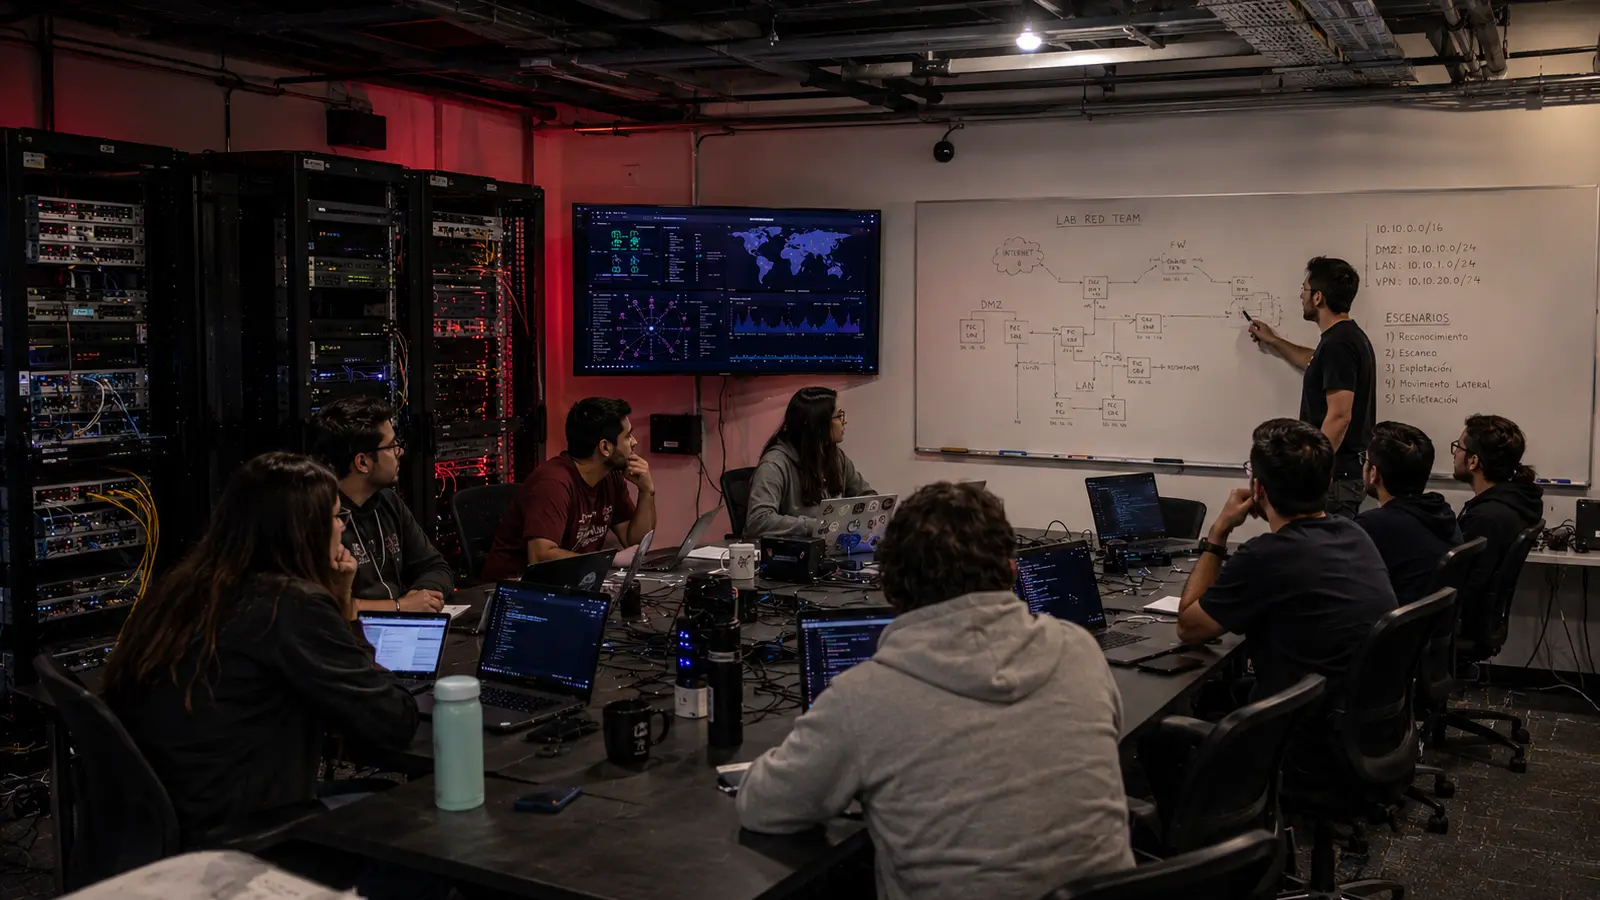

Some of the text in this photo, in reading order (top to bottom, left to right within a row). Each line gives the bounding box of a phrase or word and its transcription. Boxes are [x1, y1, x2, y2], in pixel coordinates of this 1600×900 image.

[1056, 214, 1141, 225] LAB RED TEAM
[1376, 222, 1443, 234] 10.10.0.0/16
[1170, 240, 1186, 249] FW
[1375, 242, 1476, 254] DMZ: 10.10.10.0/24
[1375, 259, 1476, 270] LAN: 10.10.1.0/24
[1376, 277, 1402, 286] VPN:
[981, 300, 1003, 309] DMZ
[1386, 313, 1450, 323] ESCENARIOS
[1385, 349, 1395, 358] 2)
[1385, 364, 1395, 373] 3)
[1075, 381, 1094, 390] LAN
[1385, 394, 1395, 404] 5)
